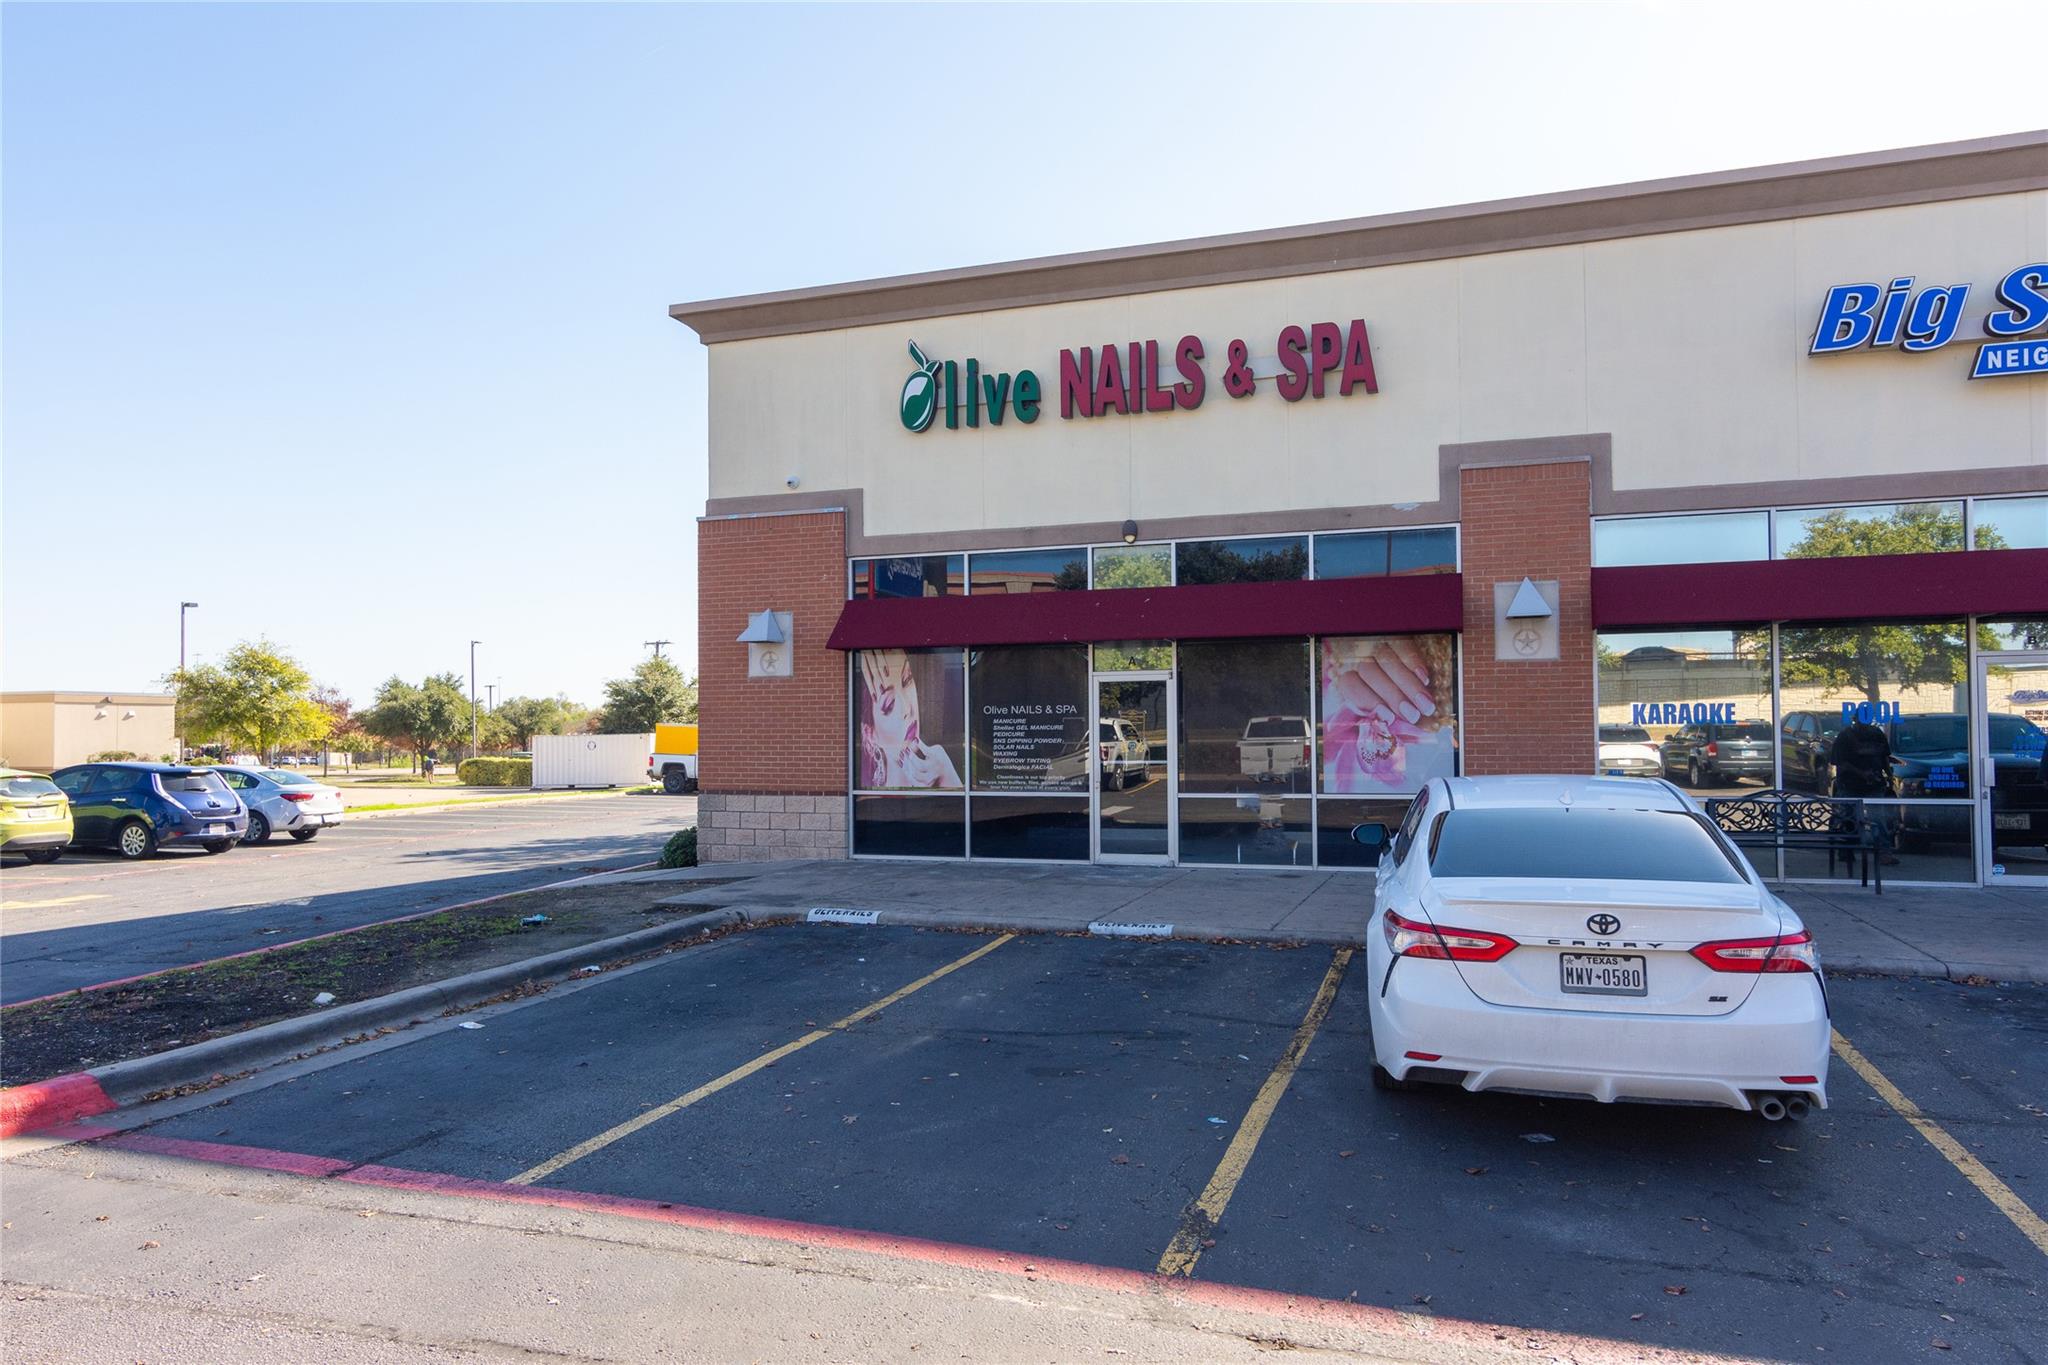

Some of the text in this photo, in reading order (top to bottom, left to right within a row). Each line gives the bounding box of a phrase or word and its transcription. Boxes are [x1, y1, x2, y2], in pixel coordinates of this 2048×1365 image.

[1809, 276, 1972, 355] Big
[900, 319, 1379, 433] Olive NAILS & SPA
[1128, 656, 1136, 666] A
[983, 705, 1077, 715] Olive NAILS & SPA
[1632, 702, 1737, 725] KARAOKE
[1842, 701, 1905, 726] POOL
[1547, 939, 1664, 949] CAMRY
[1587, 957, 1619, 966] TEXAS
